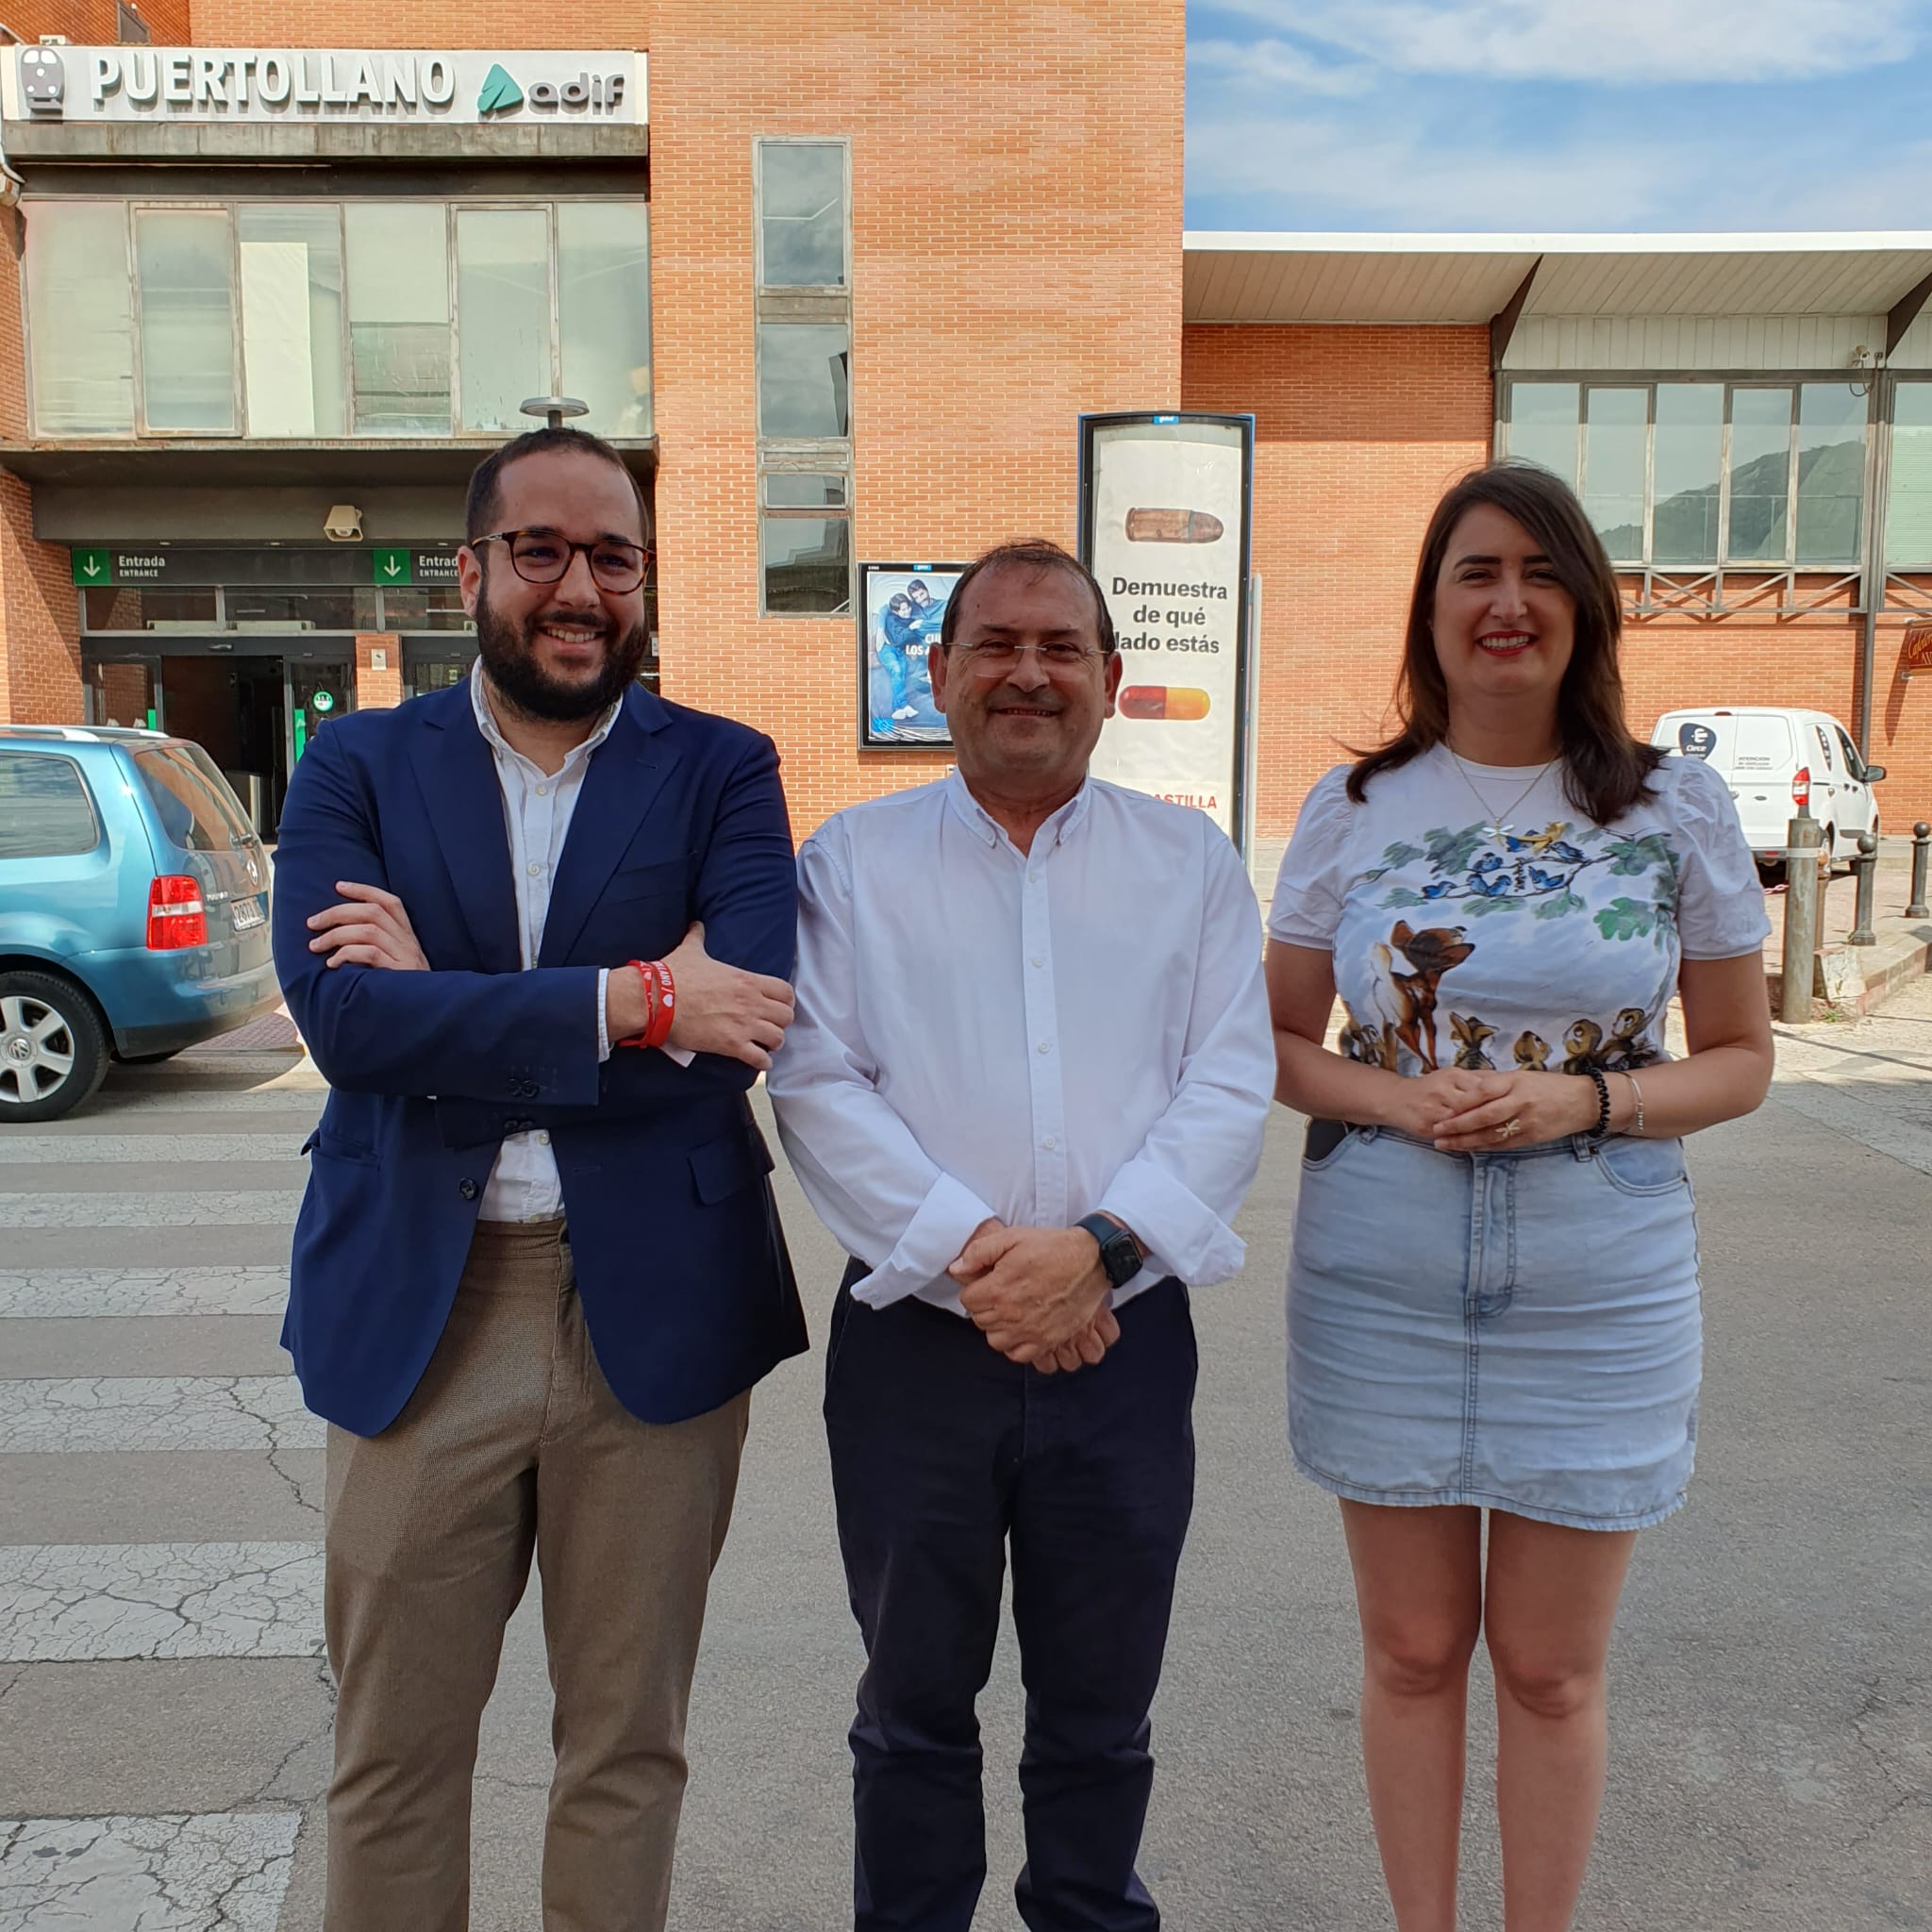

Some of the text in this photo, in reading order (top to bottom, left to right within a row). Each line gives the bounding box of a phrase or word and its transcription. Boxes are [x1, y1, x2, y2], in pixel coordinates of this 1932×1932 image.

[90, 50, 625, 104] PUERTOLLANO adif
[119, 555, 166, 567] Entrada
[419, 555, 458, 567] Entrad
[119, 569, 159, 577] ENTRANCE
[1111, 576, 1228, 600] Demuestra
[1133, 604, 1207, 629] de qué
[906, 644, 924, 656] LOS
[1114, 630, 1220, 654] lado estás
